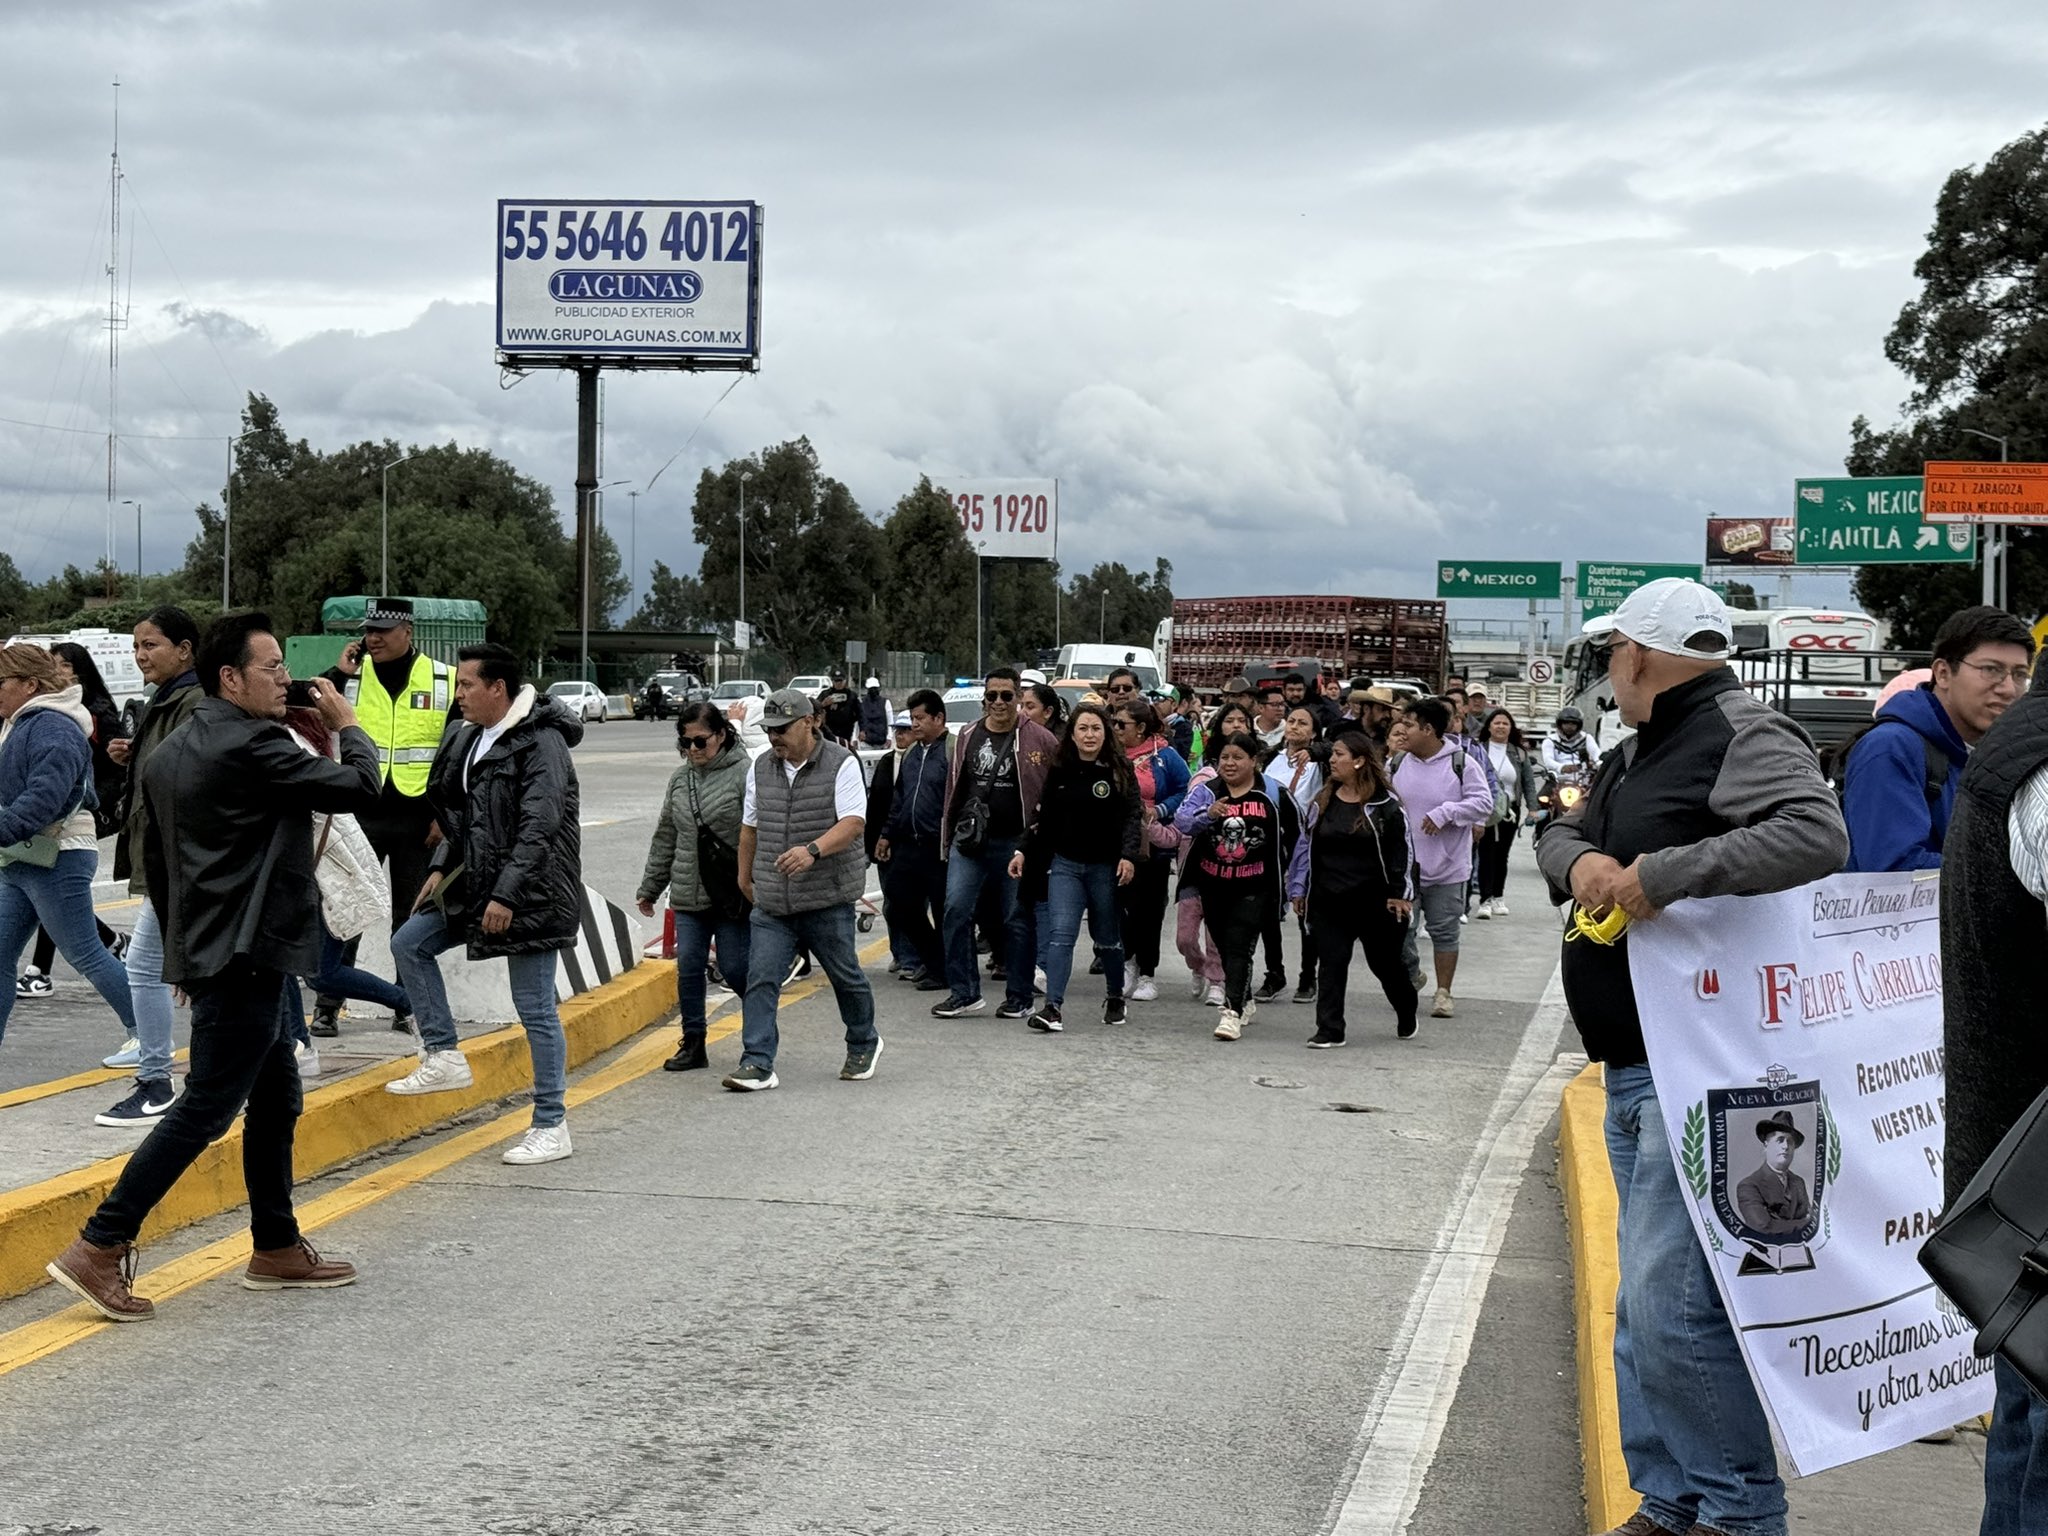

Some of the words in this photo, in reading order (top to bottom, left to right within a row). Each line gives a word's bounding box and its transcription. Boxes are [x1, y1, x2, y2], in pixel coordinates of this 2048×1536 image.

[504, 210, 548, 261] 55
[555, 210, 648, 261] 5646
[660, 211, 748, 262] 4012
[557, 274, 695, 298] LAGUNAS
[555, 306, 628, 318] PUBLICIDAD
[632, 307, 695, 319] EXTERIOR
[507, 328, 742, 344] WWW.GRUPOLAGUNAS.COM.MX
[2001, 467, 2042, 475] ALTERNAS
[1972, 483, 2023, 495] ZARAGOZA
[946, 494, 984, 532] 35
[993, 494, 1047, 533] 1920
[1930, 500, 1947, 513] POR
[1977, 501, 2048, 515] MÉXICO-CUAUTL
[1952, 532, 1968, 544] 115
[1473, 574, 1537, 585] MEXICO
[1588, 575, 1622, 586] Pachuca
[1813, 891, 1859, 921] ESCUELA
[1762, 963, 1852, 1024] FELIPE
[1853, 951, 1942, 1005] CARRILLO
[1871, 1101, 1937, 1144] NUESTRA
[1713, 1111, 1726, 1173] PRIMARIA
[1858, 1388, 1875, 1432] y
[1878, 1365, 1924, 1409] otra
